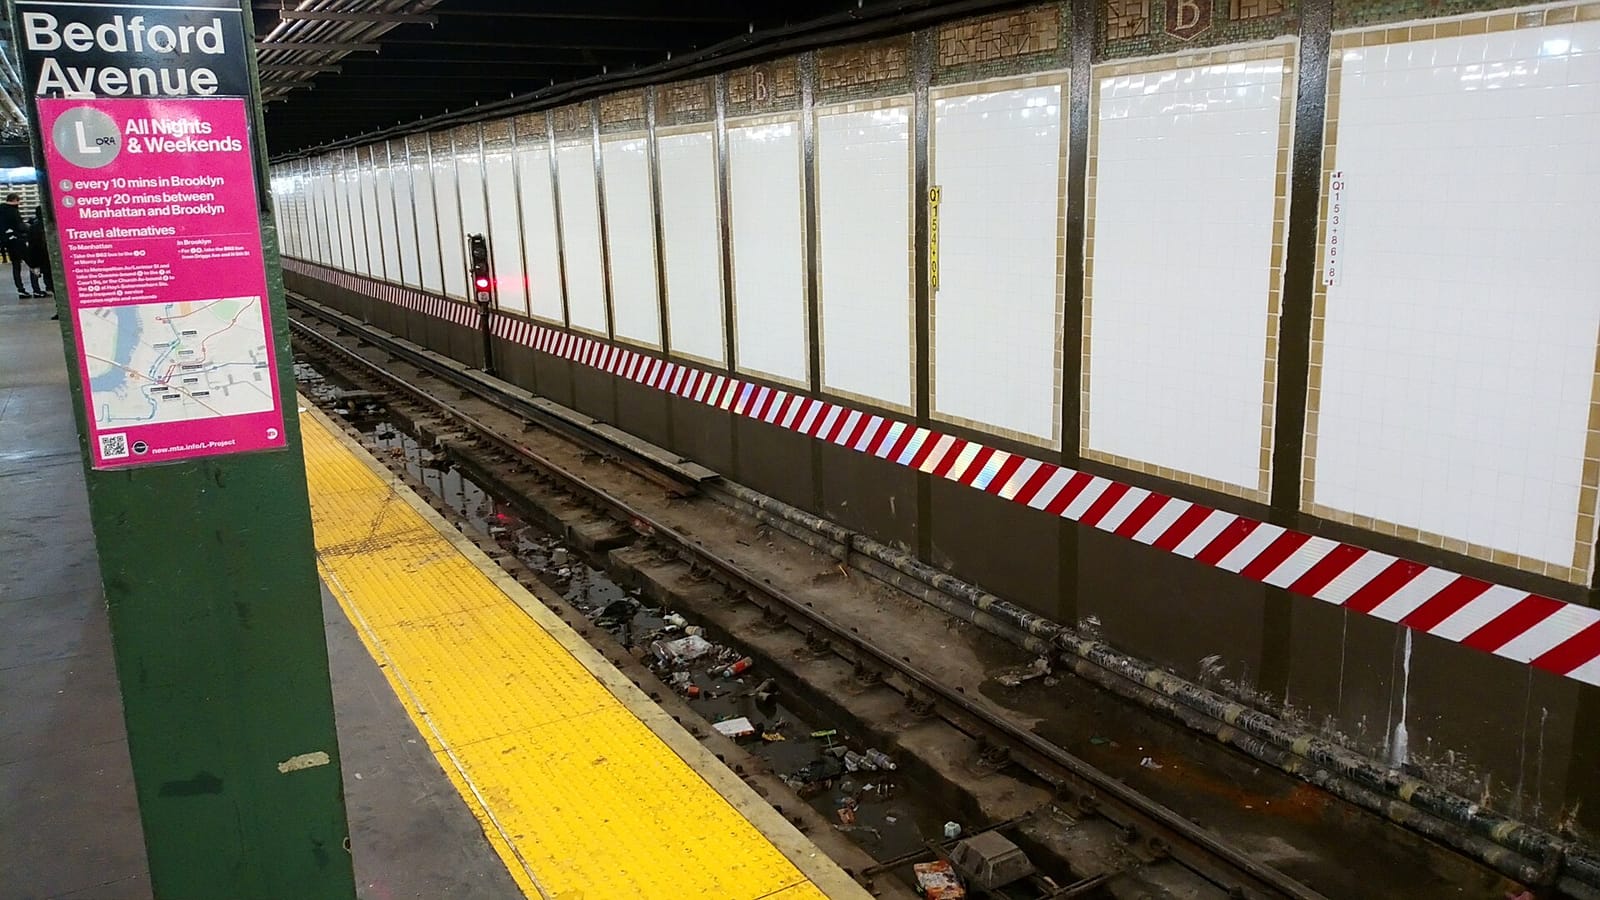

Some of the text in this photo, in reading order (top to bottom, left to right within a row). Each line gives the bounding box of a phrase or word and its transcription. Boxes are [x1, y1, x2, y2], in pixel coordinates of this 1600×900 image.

[23, 12, 225, 54] Bedford
[37, 57, 219, 95] Avenue
[755, 71, 767, 100] B
[125, 118, 213, 138] All Nights
[75, 121, 101, 154] L
[127, 136, 243, 153] & Weekends
[74, 180, 110, 191] every
[111, 178, 126, 188] 10
[127, 177, 158, 189] mins
[158, 176, 170, 187] in
[171, 175, 225, 188] Brooklyn
[77, 196, 112, 207] every
[114, 193, 130, 204] 20
[132, 192, 162, 203] mins
[162, 191, 215, 203] between
[79, 204, 225, 219] Manhattan and Brooklyn
[66, 225, 176, 240] Travel alternatives
